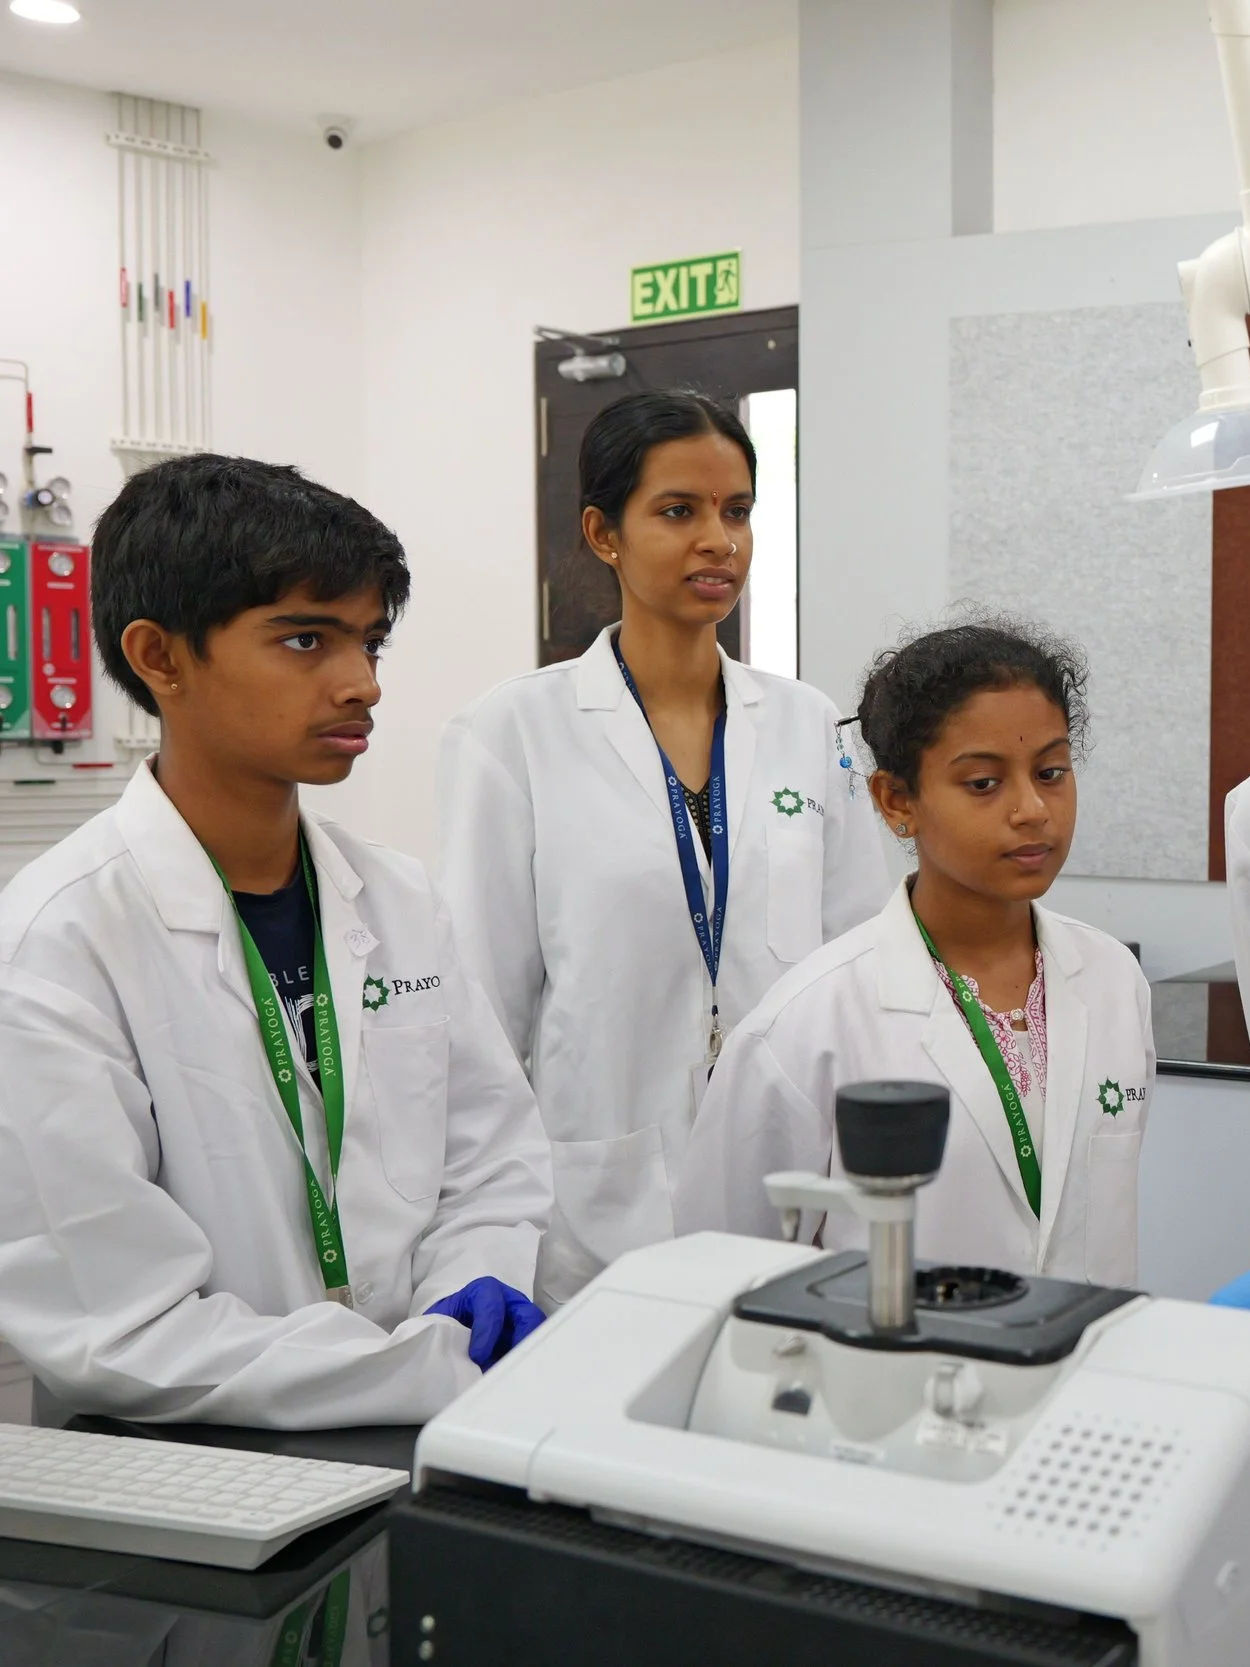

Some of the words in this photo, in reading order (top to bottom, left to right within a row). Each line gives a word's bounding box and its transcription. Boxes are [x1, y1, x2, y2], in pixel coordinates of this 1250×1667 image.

[633, 262, 714, 316] EXIT
[671, 788, 686, 839] PRAYOGA
[712, 776, 722, 822] PRAYOGA
[391, 975, 441, 996] PRAYO
[263, 996, 288, 1066] PRAYOGA
[318, 1010, 335, 1076] PRAYOGA
[1003, 1083, 1028, 1143] PRAYOGA
[310, 1179, 333, 1247] PRAYOGA
